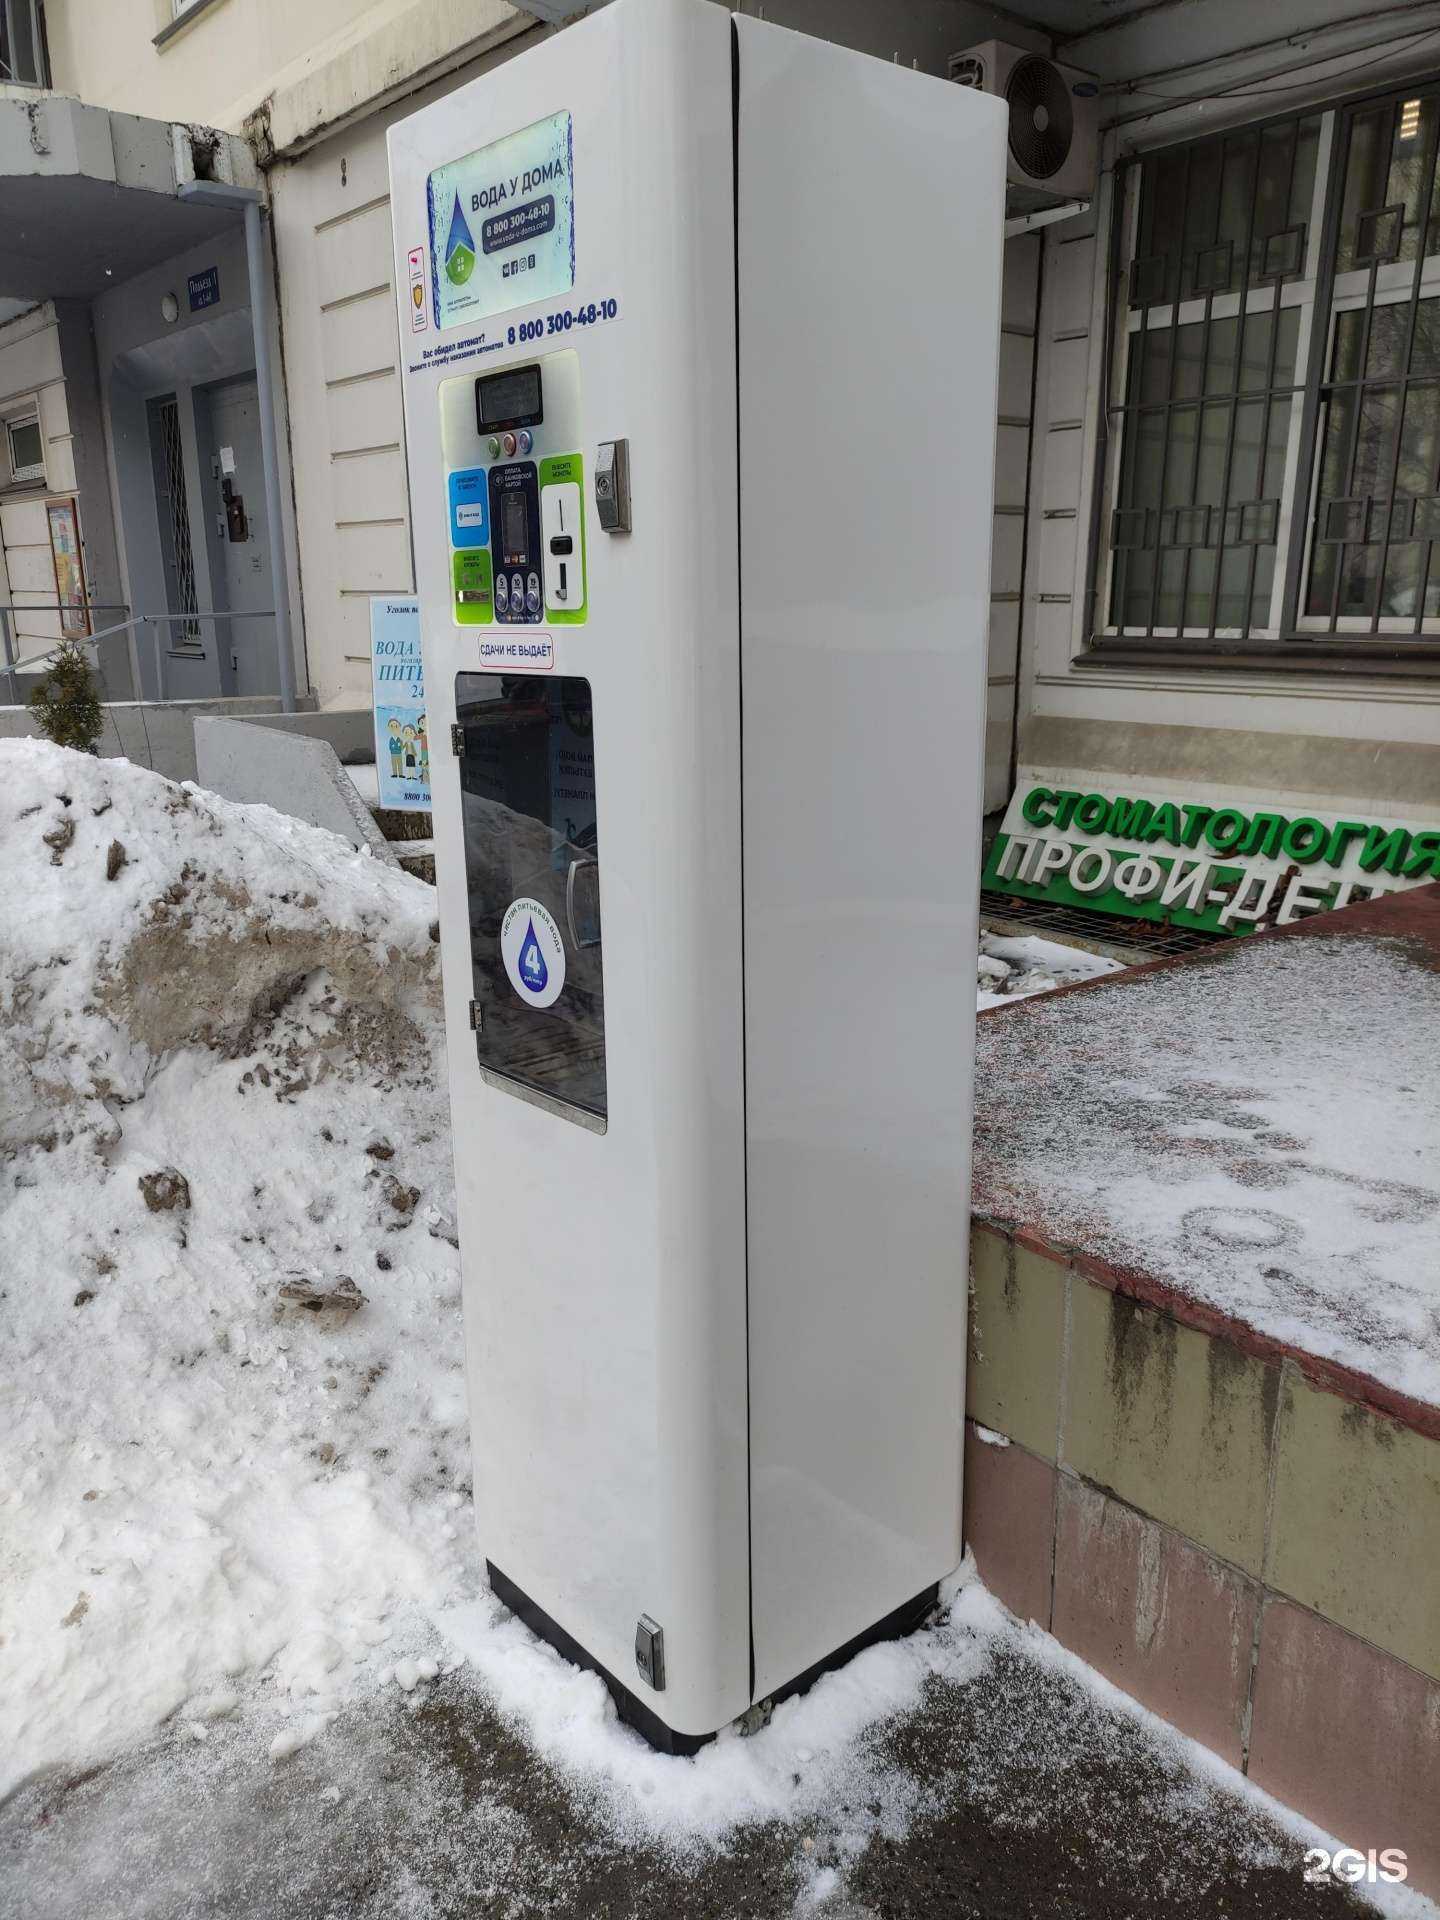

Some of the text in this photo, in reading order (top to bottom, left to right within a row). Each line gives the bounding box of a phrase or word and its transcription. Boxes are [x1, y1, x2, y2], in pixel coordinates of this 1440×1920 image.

[471, 158, 564, 213] ВОДА У ДОМА
[486, 202, 550, 238] 8 800 300-48-10
[507, 298, 617, 346] 8 800 300-48-10
[409, 362, 428, 373] Звоните
[431, 355, 450, 368] службу
[450, 349, 476, 362] наказания
[476, 341, 504, 356] автоматов
[422, 332, 486, 360] Вас обидел автомат?
[499, 578, 504, 586] 5
[514, 578, 521, 587] 10
[387, 605, 410, 614] Уголок
[376, 641, 414, 656] ВОДА
[480, 642, 551, 659] СДАЧИ НЕ ВЫДАЁТ
[411, 685, 425, 698] 24
[403, 792, 420, 801] 8800
[1022, 787, 1440, 881] СТОМАТОЛОГИЯ
[525, 944, 541, 975] 4
